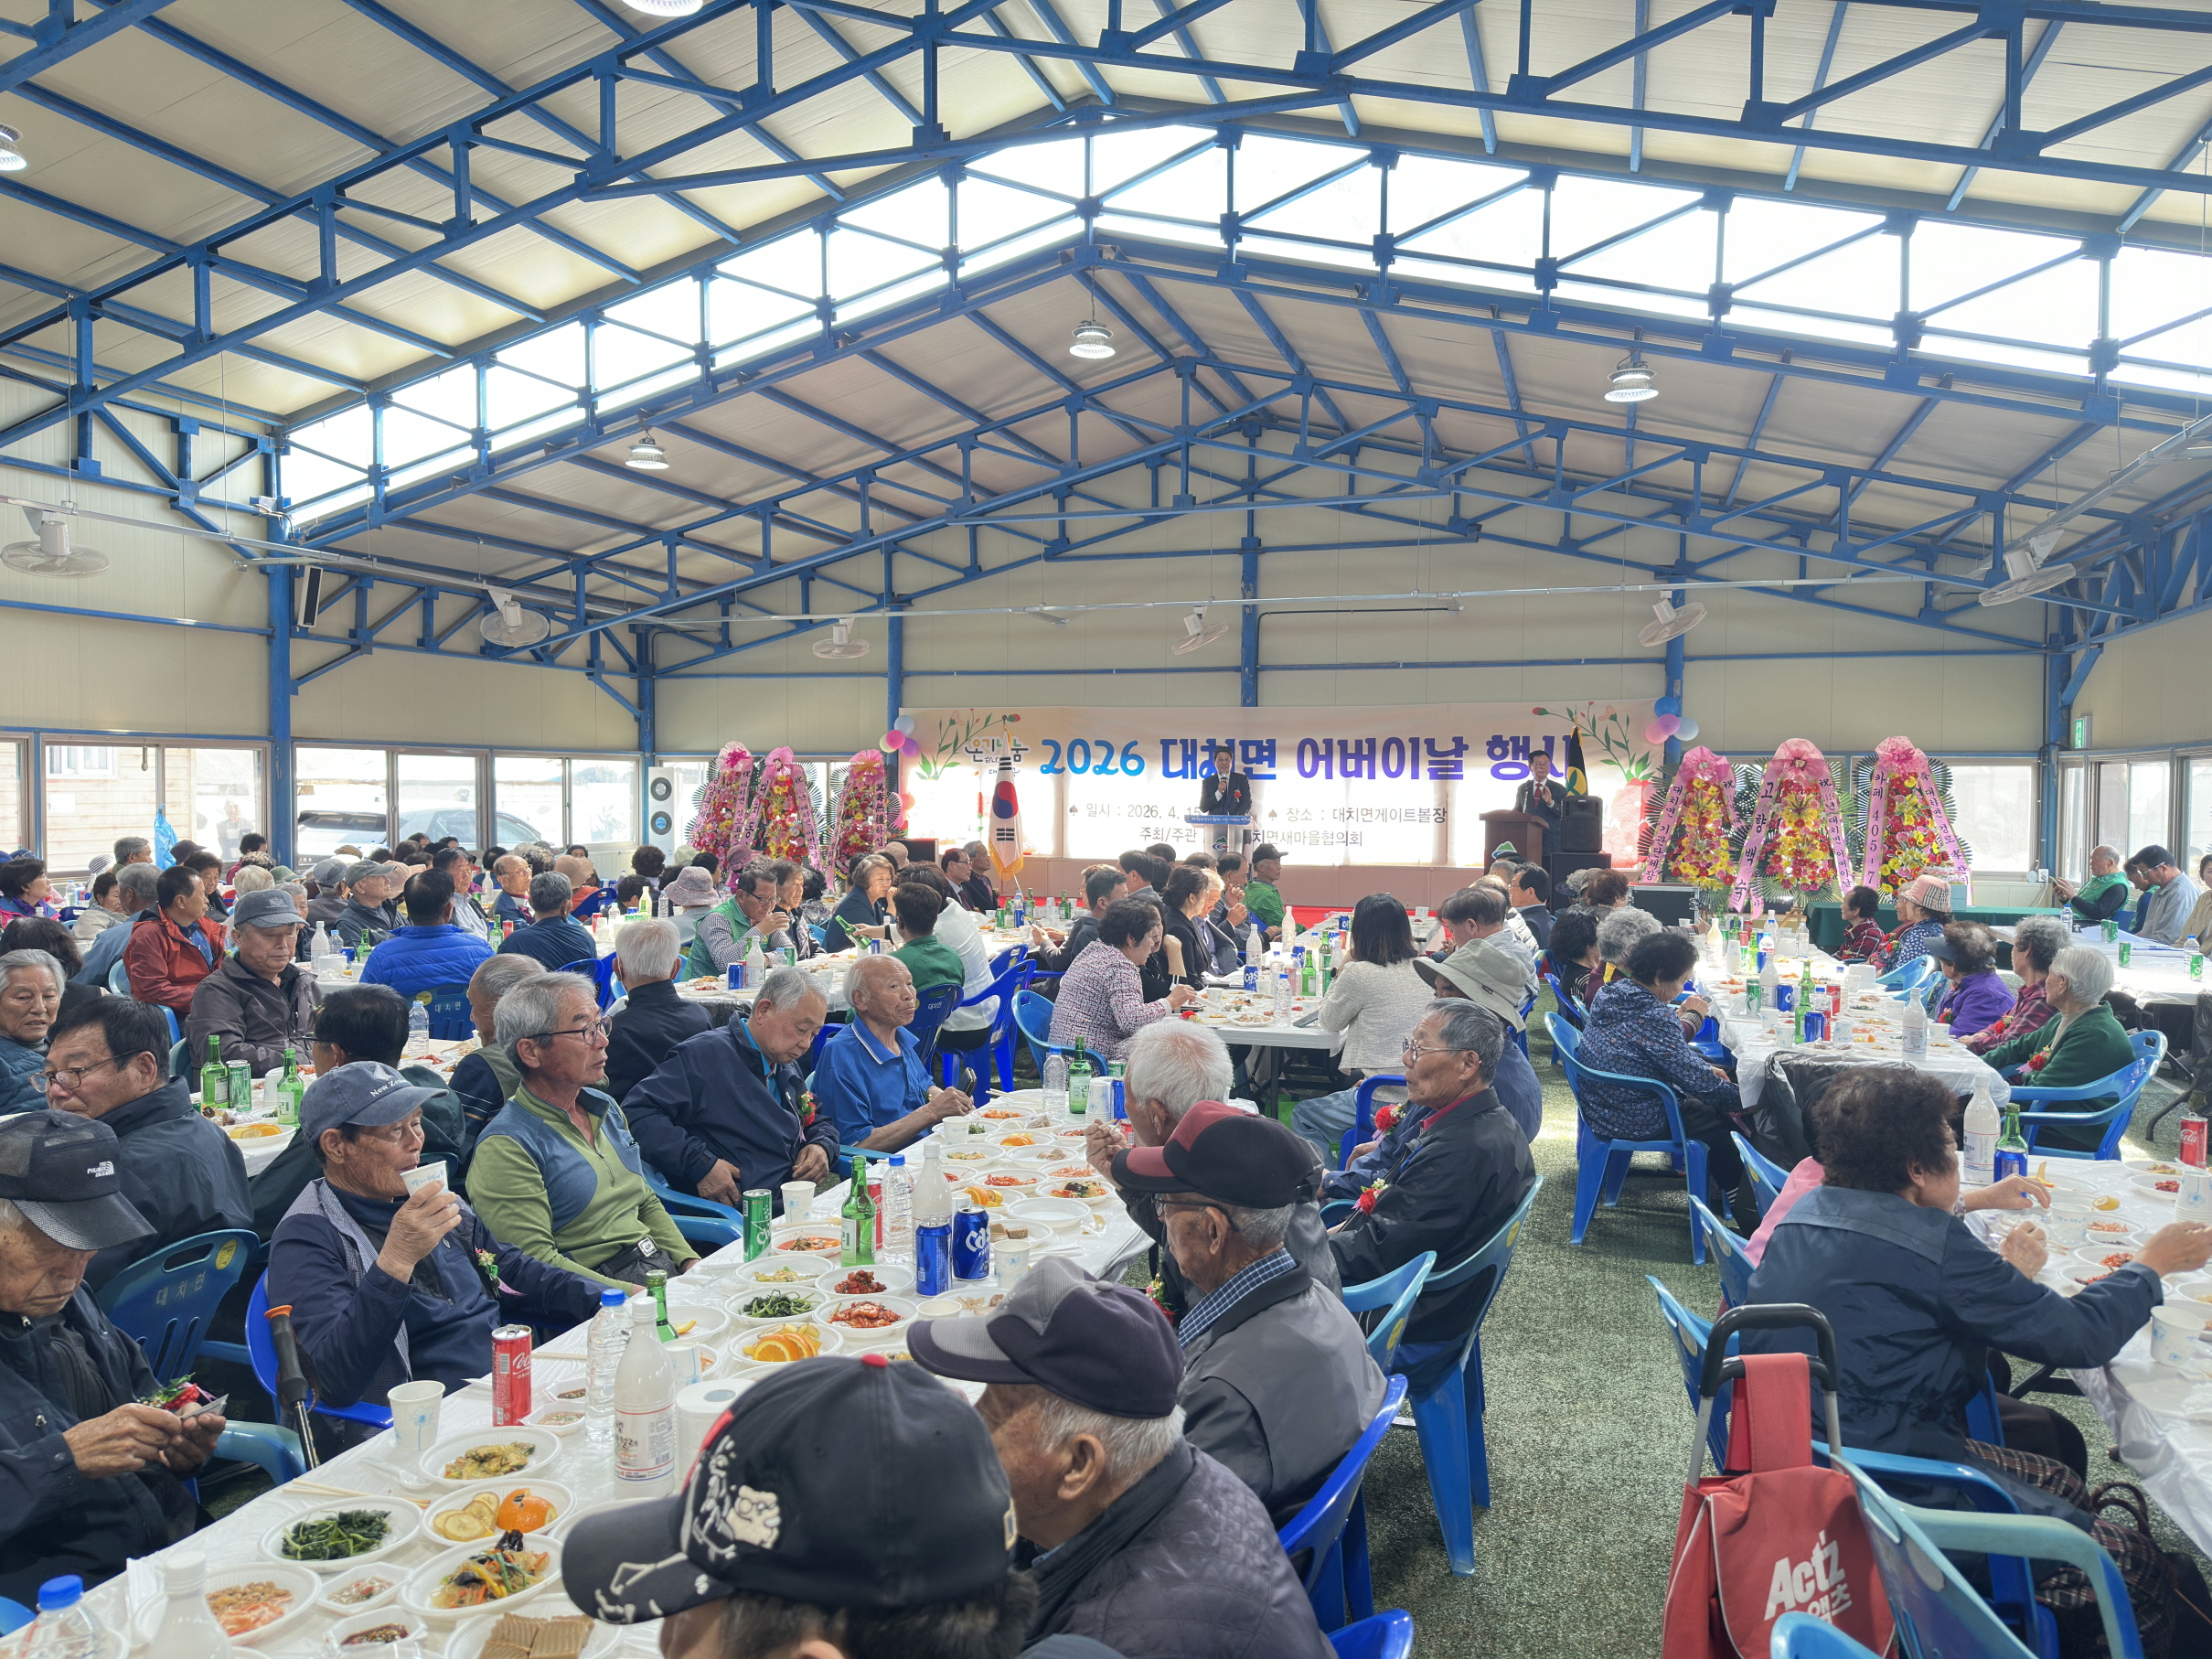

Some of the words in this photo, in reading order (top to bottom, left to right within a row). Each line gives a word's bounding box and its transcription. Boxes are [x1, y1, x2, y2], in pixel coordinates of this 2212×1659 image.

[1040, 738, 1145, 776] 2026
[1159, 738, 1277, 780] 대치면
[1297, 736, 1469, 780] 어버이날
[1485, 734, 1572, 781] 행사
[1085, 802, 1111, 818] 일시
[1127, 804, 1162, 819] 2026.
[1286, 808, 1314, 821] 장소
[1332, 807, 1448, 823] 대치면게이트볼장
[1665, 785, 1683, 818] 대치면
[1925, 787, 1942, 819] 대치면
[1139, 826, 1198, 843] 주최/주관
[1253, 829, 1362, 847] 치면새마을협의회
[1645, 824, 1671, 881] 기관단체장
[369, 1085, 389, 1097] New
